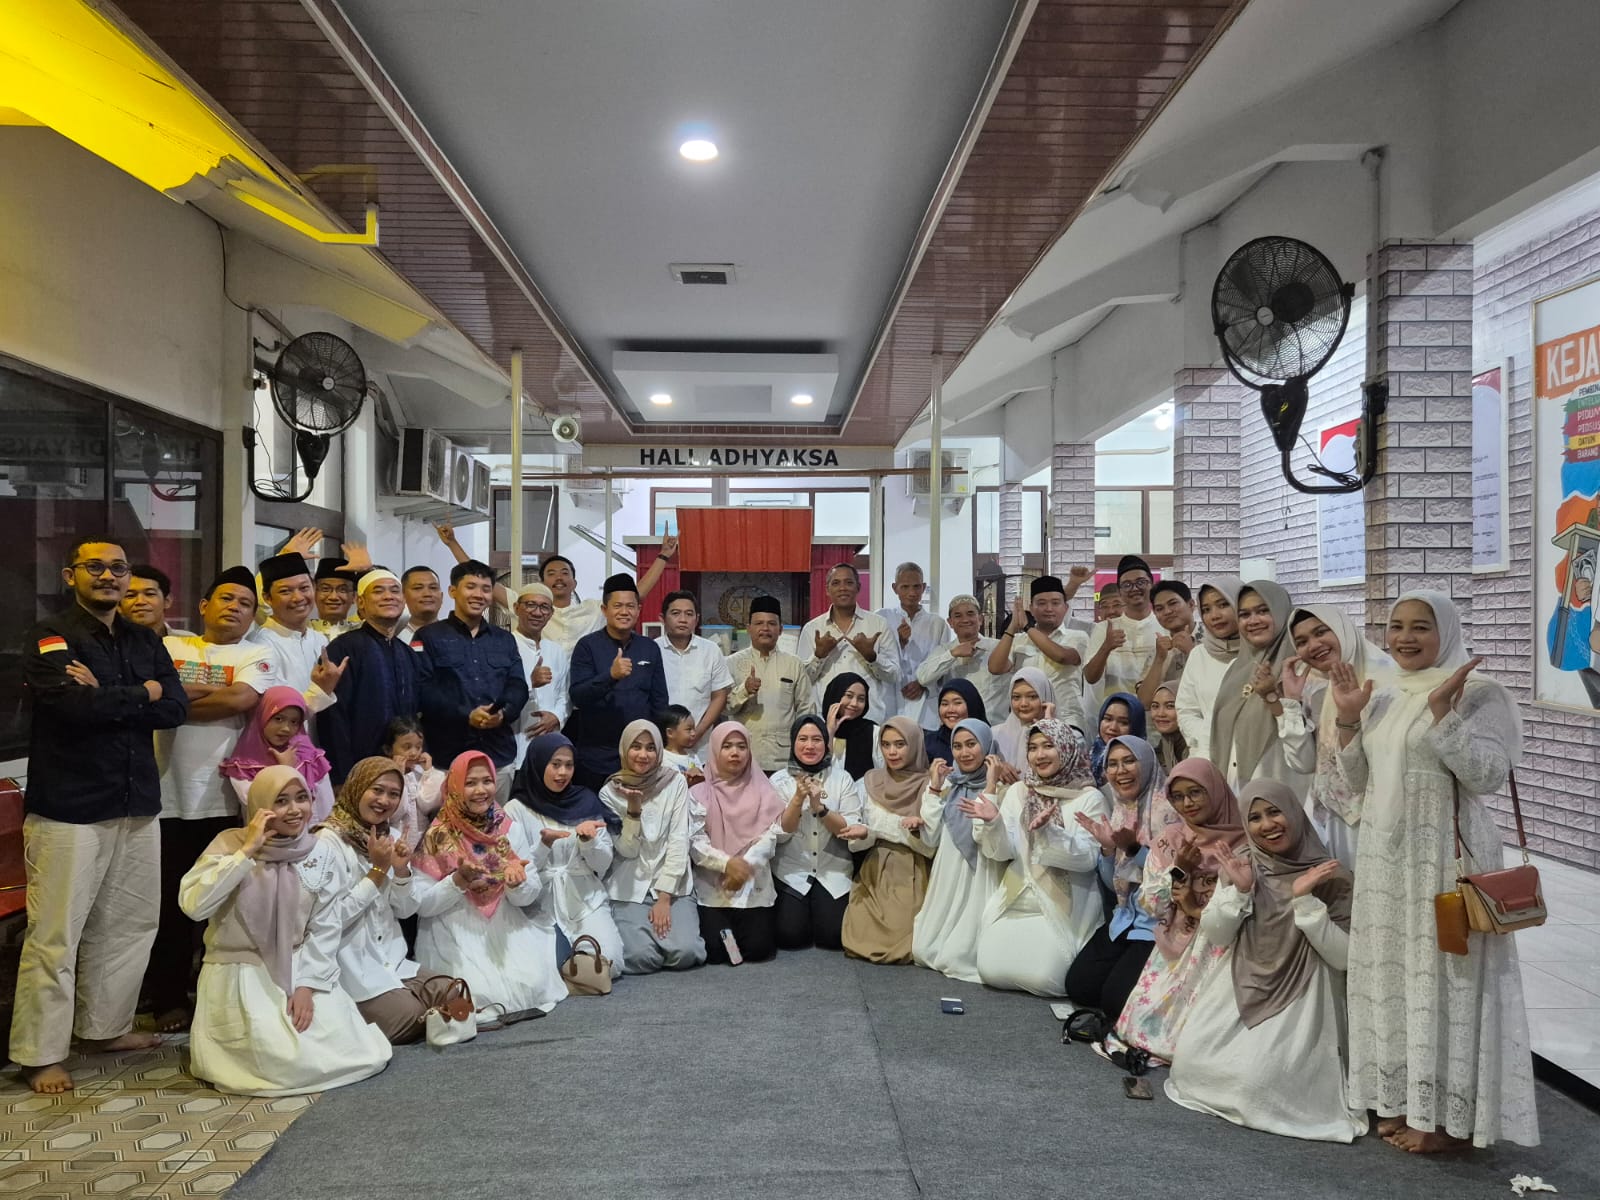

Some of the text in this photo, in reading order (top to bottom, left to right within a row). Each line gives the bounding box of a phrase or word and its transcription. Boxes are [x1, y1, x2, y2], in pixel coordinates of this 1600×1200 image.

[1547, 332, 1600, 389] KEJA
[1579, 384, 1600, 397] PEMBIN
[641, 449, 839, 466] HALL ADHYAKSA
